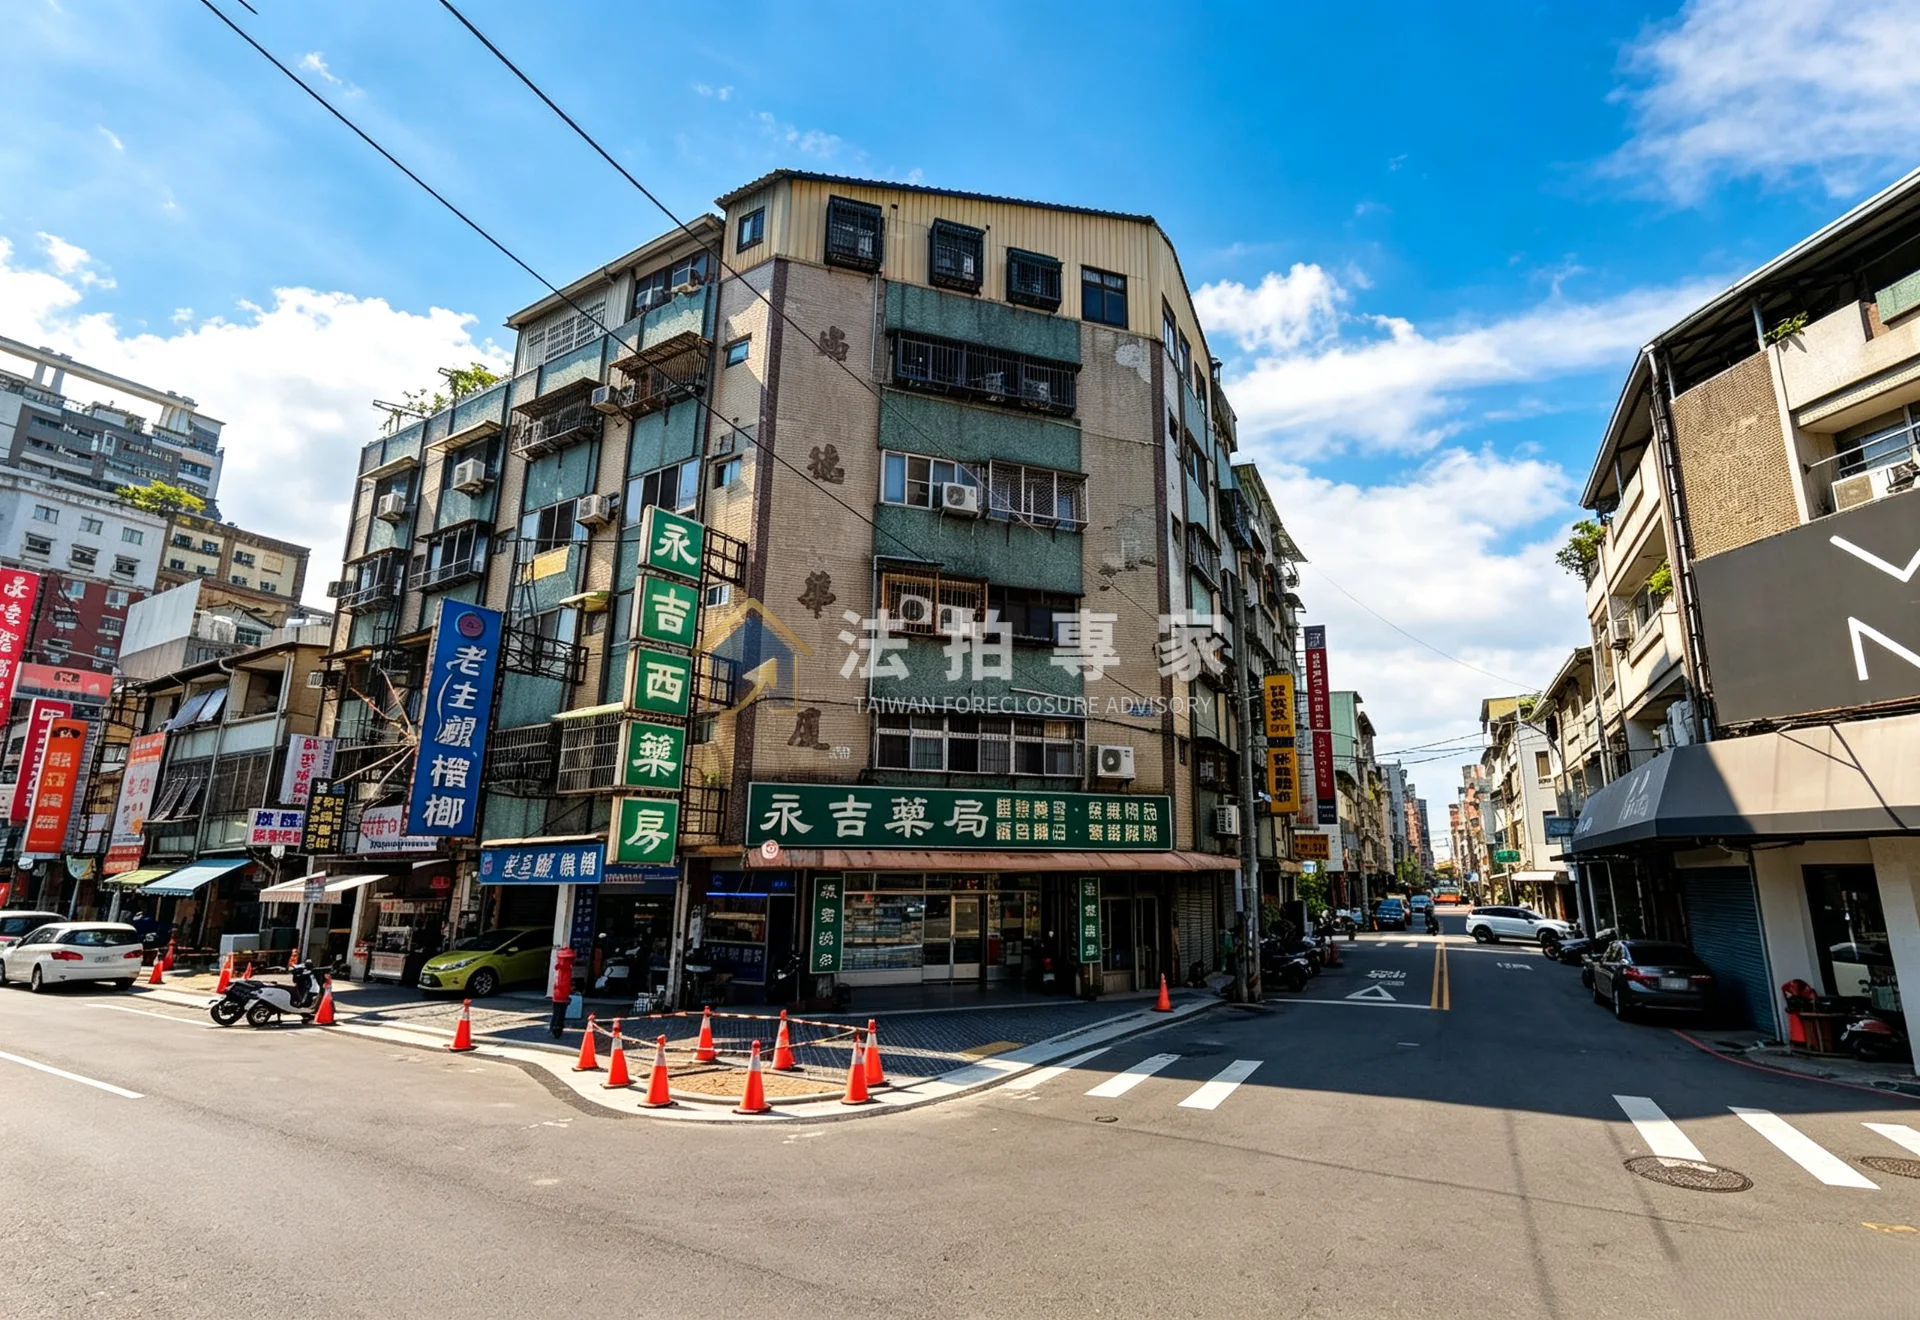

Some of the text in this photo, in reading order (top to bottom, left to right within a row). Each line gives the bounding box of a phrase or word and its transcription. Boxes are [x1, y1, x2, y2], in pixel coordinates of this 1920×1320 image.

[625, 523, 698, 854] 永吉西藥房
[759, 794, 990, 838] 永吉藥局
